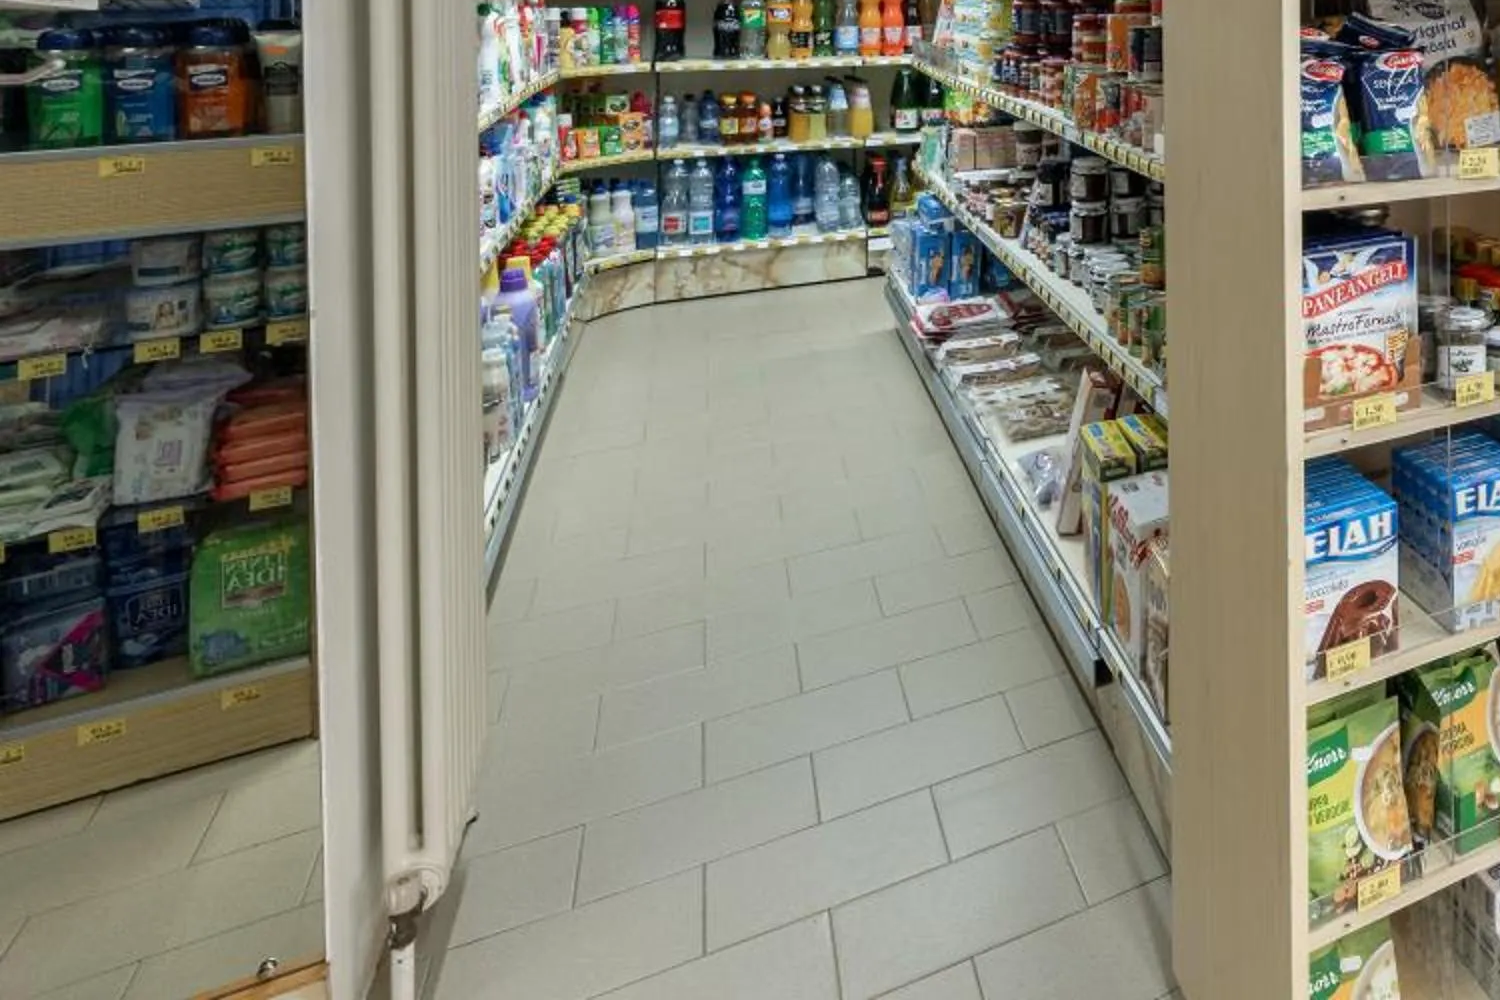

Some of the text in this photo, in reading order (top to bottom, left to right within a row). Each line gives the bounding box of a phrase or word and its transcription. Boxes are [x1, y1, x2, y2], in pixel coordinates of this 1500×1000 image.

[1411, 16, 1467, 42] riginal
[1303, 263, 1406, 317] PANEANGELI
[1305, 509, 1396, 561] ELAH
[1310, 971, 1339, 996] norr
